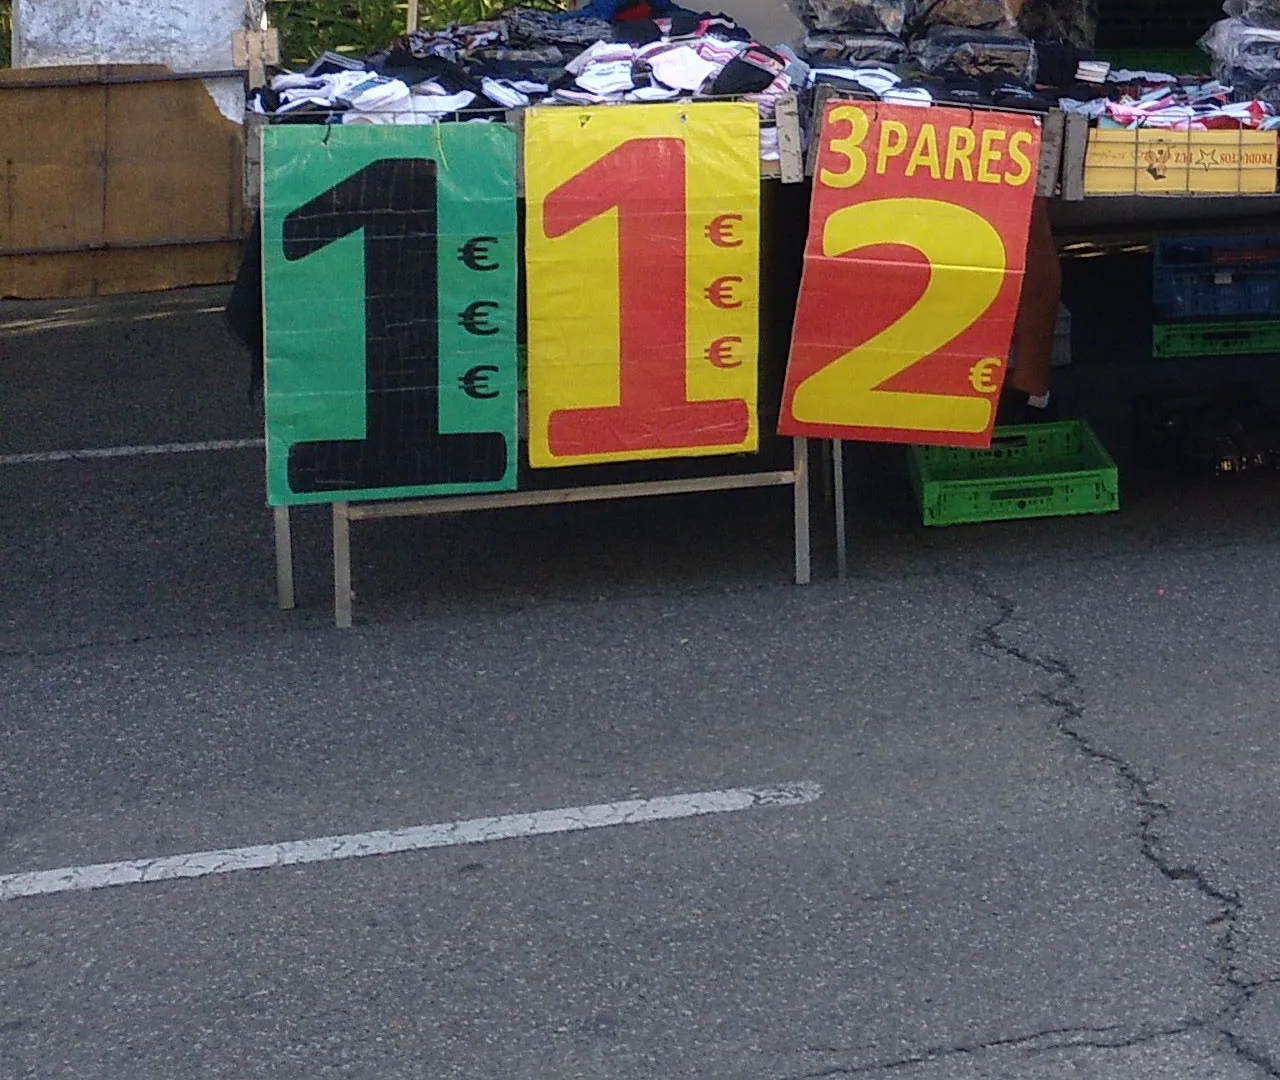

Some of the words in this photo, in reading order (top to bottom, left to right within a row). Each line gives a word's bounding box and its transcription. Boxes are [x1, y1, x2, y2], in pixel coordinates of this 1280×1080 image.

[819, 104, 870, 189] 3
[875, 118, 1034, 187] PARES
[281, 156, 509, 496] 1
[541, 135, 751, 458] 1
[790, 197, 1007, 434] 2
